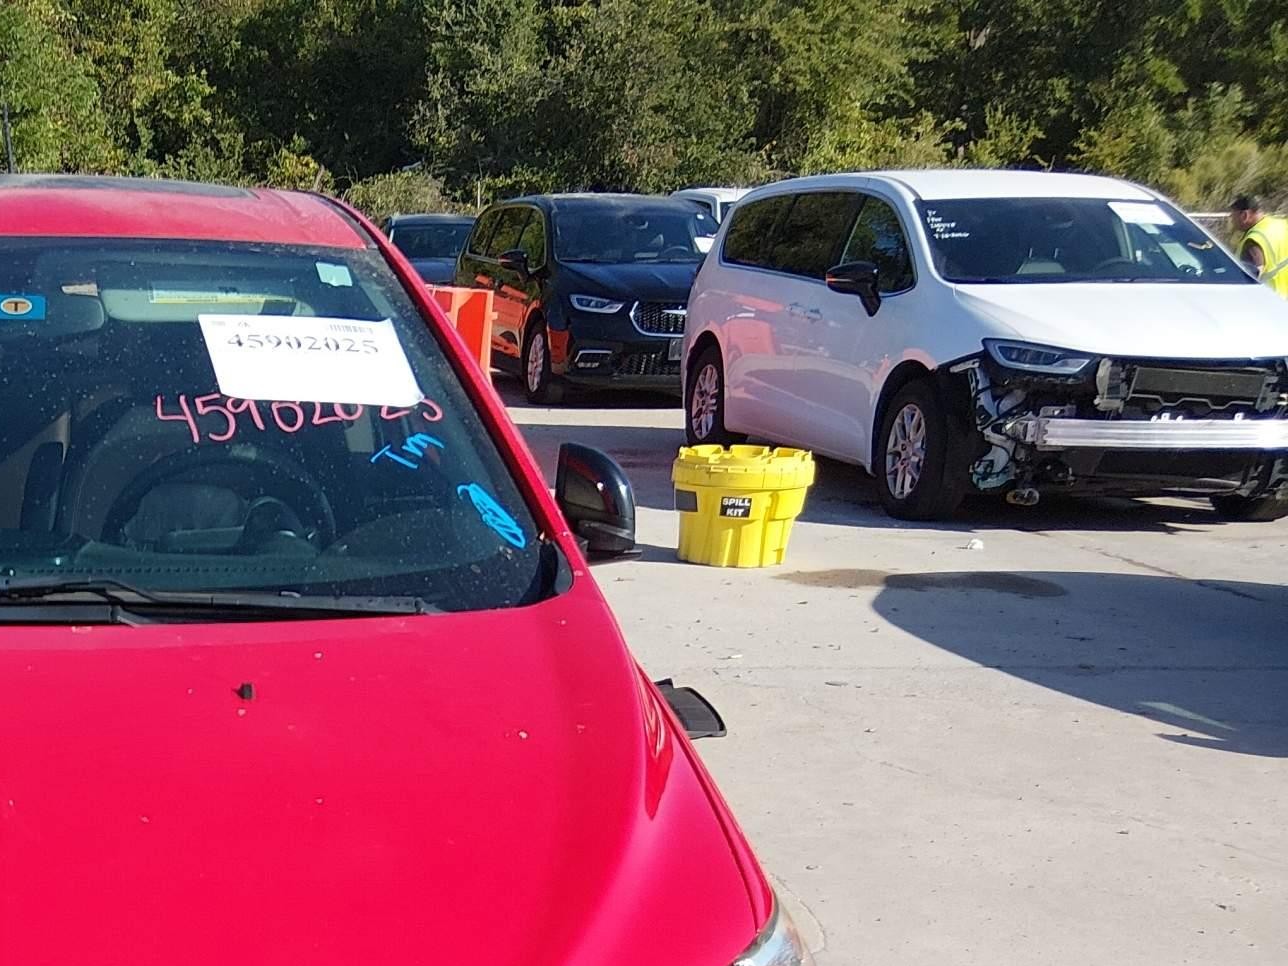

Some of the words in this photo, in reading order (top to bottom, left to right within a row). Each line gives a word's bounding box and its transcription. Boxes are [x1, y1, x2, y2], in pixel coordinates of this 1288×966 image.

[227, 334, 379, 354] 45902025
[722, 497, 751, 507] SPILL
[726, 508, 745, 517] KIT
